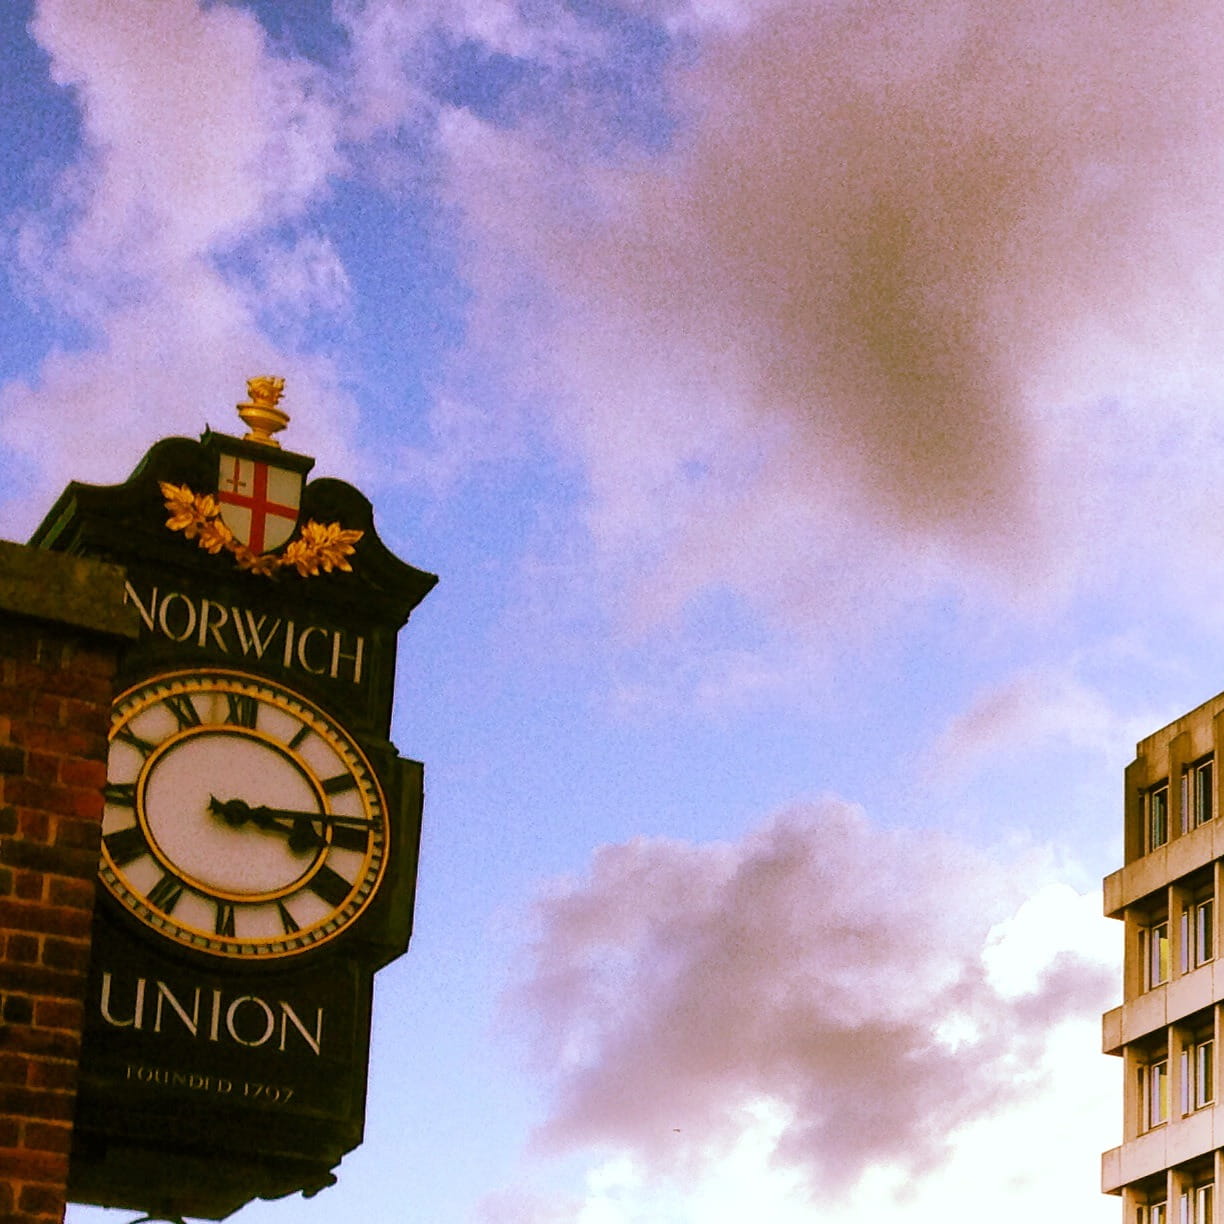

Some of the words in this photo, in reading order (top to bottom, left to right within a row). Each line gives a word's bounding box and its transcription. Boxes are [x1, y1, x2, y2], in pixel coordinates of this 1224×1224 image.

[123, 580, 365, 685] NORWICH
[100, 972, 324, 1057] UNION
[126, 1064, 232, 1094] FOUNDED
[243, 1081, 295, 1105] 1797
